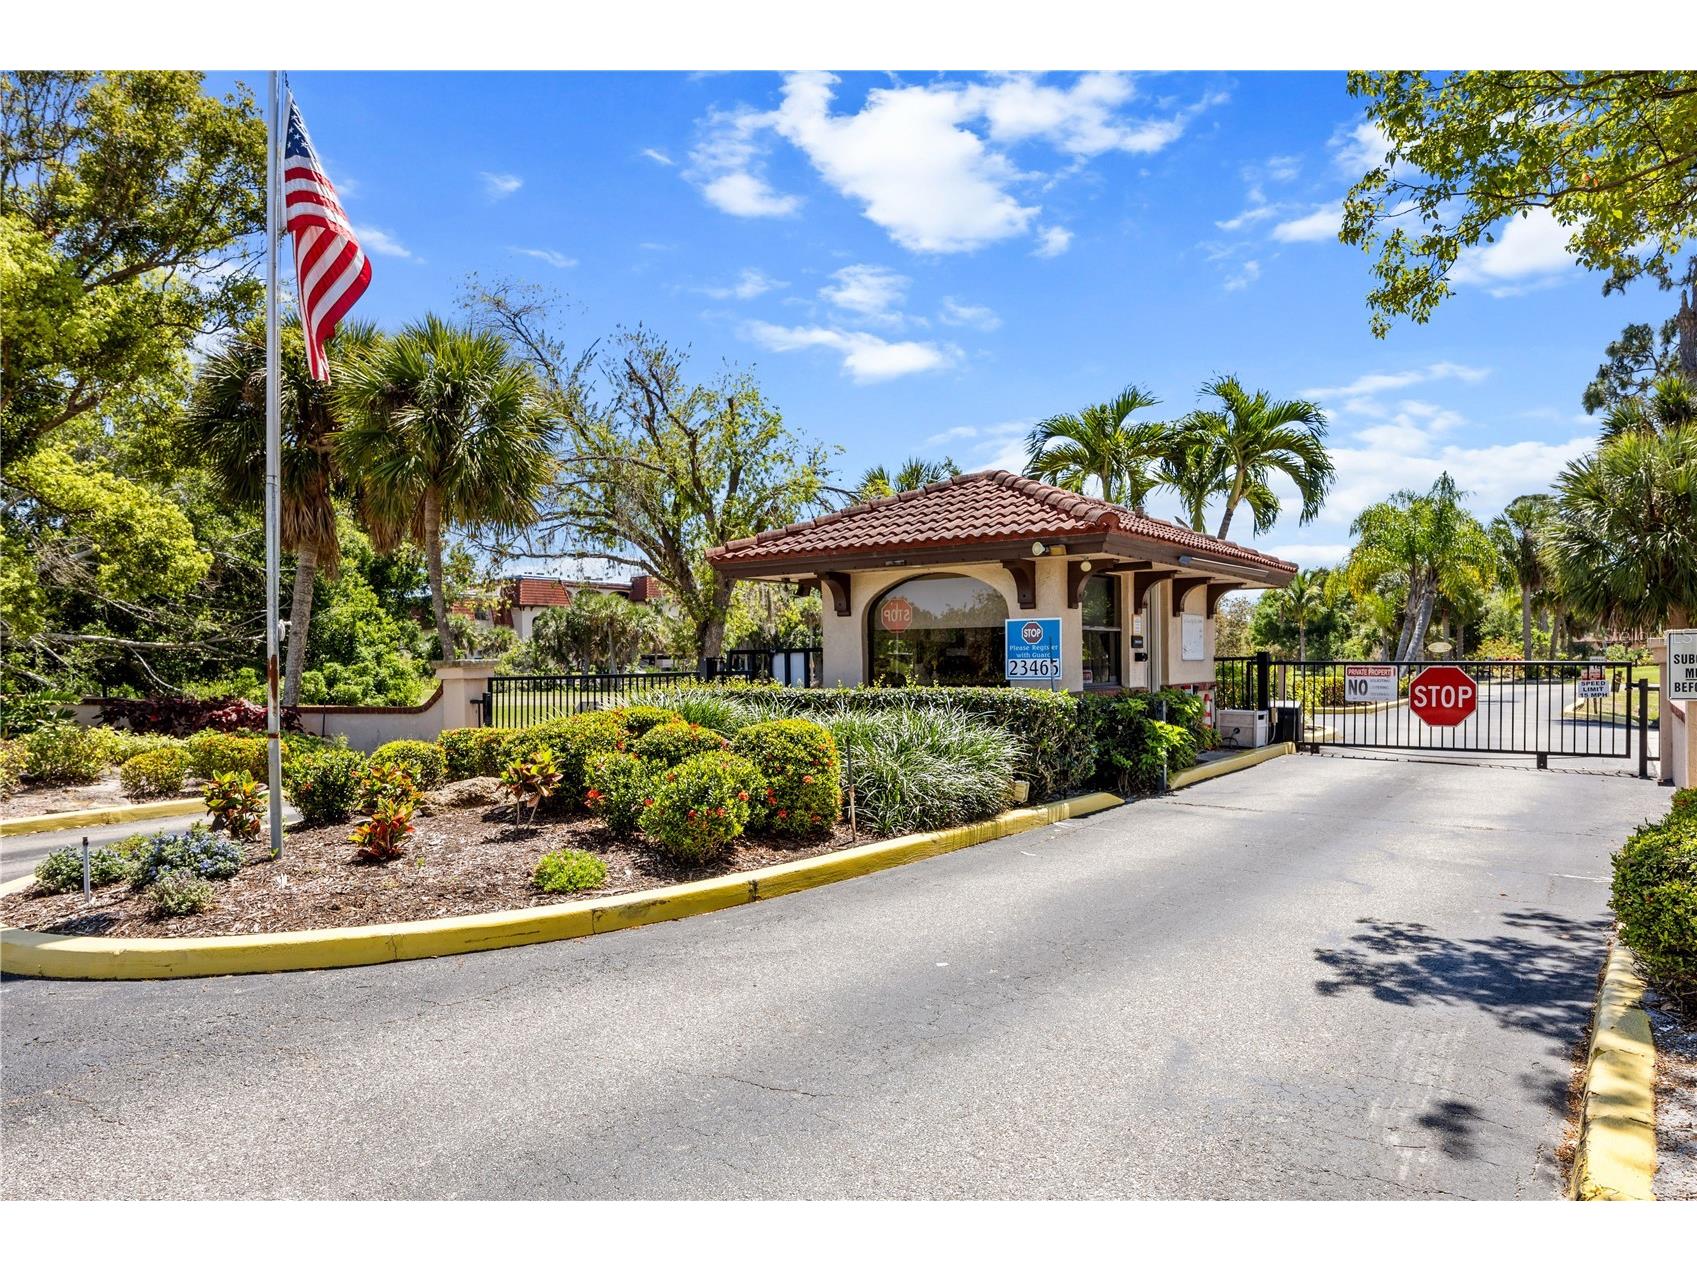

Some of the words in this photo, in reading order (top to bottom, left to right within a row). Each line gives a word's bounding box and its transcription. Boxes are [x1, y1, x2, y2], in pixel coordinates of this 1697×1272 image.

[1023, 628, 1041, 638] STOP
[1673, 653, 1697, 665] SUB
[1348, 667, 1367, 676] PRIVATE
[1685, 668, 1697, 679] M
[1348, 679, 1368, 696] NO
[1413, 685, 1473, 708] STOP
